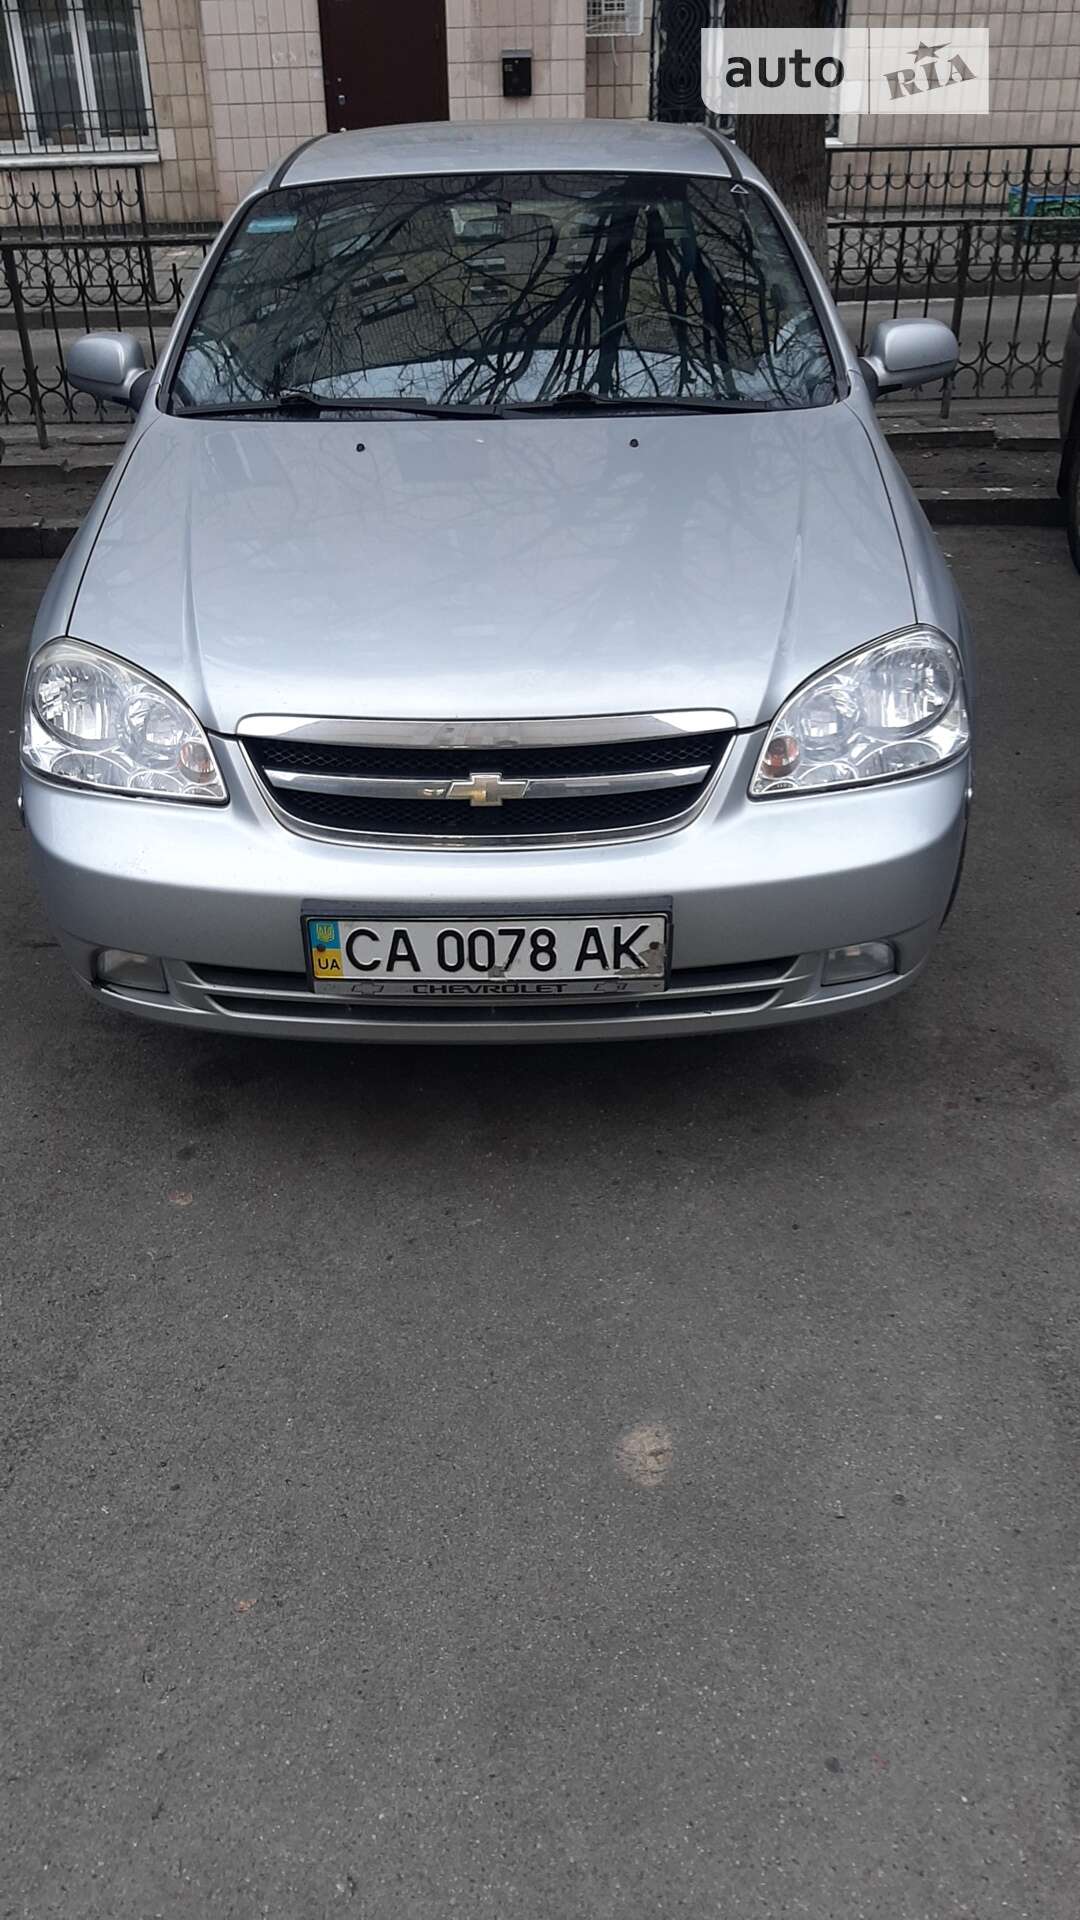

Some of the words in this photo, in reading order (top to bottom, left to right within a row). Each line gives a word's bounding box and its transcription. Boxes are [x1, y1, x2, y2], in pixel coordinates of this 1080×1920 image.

[345, 927, 421, 972] CA
[436, 927, 557, 973] 0078
[574, 924, 650, 971] AK
[318, 957, 341, 971] UA
[412, 983, 568, 995] CHEVROLET
